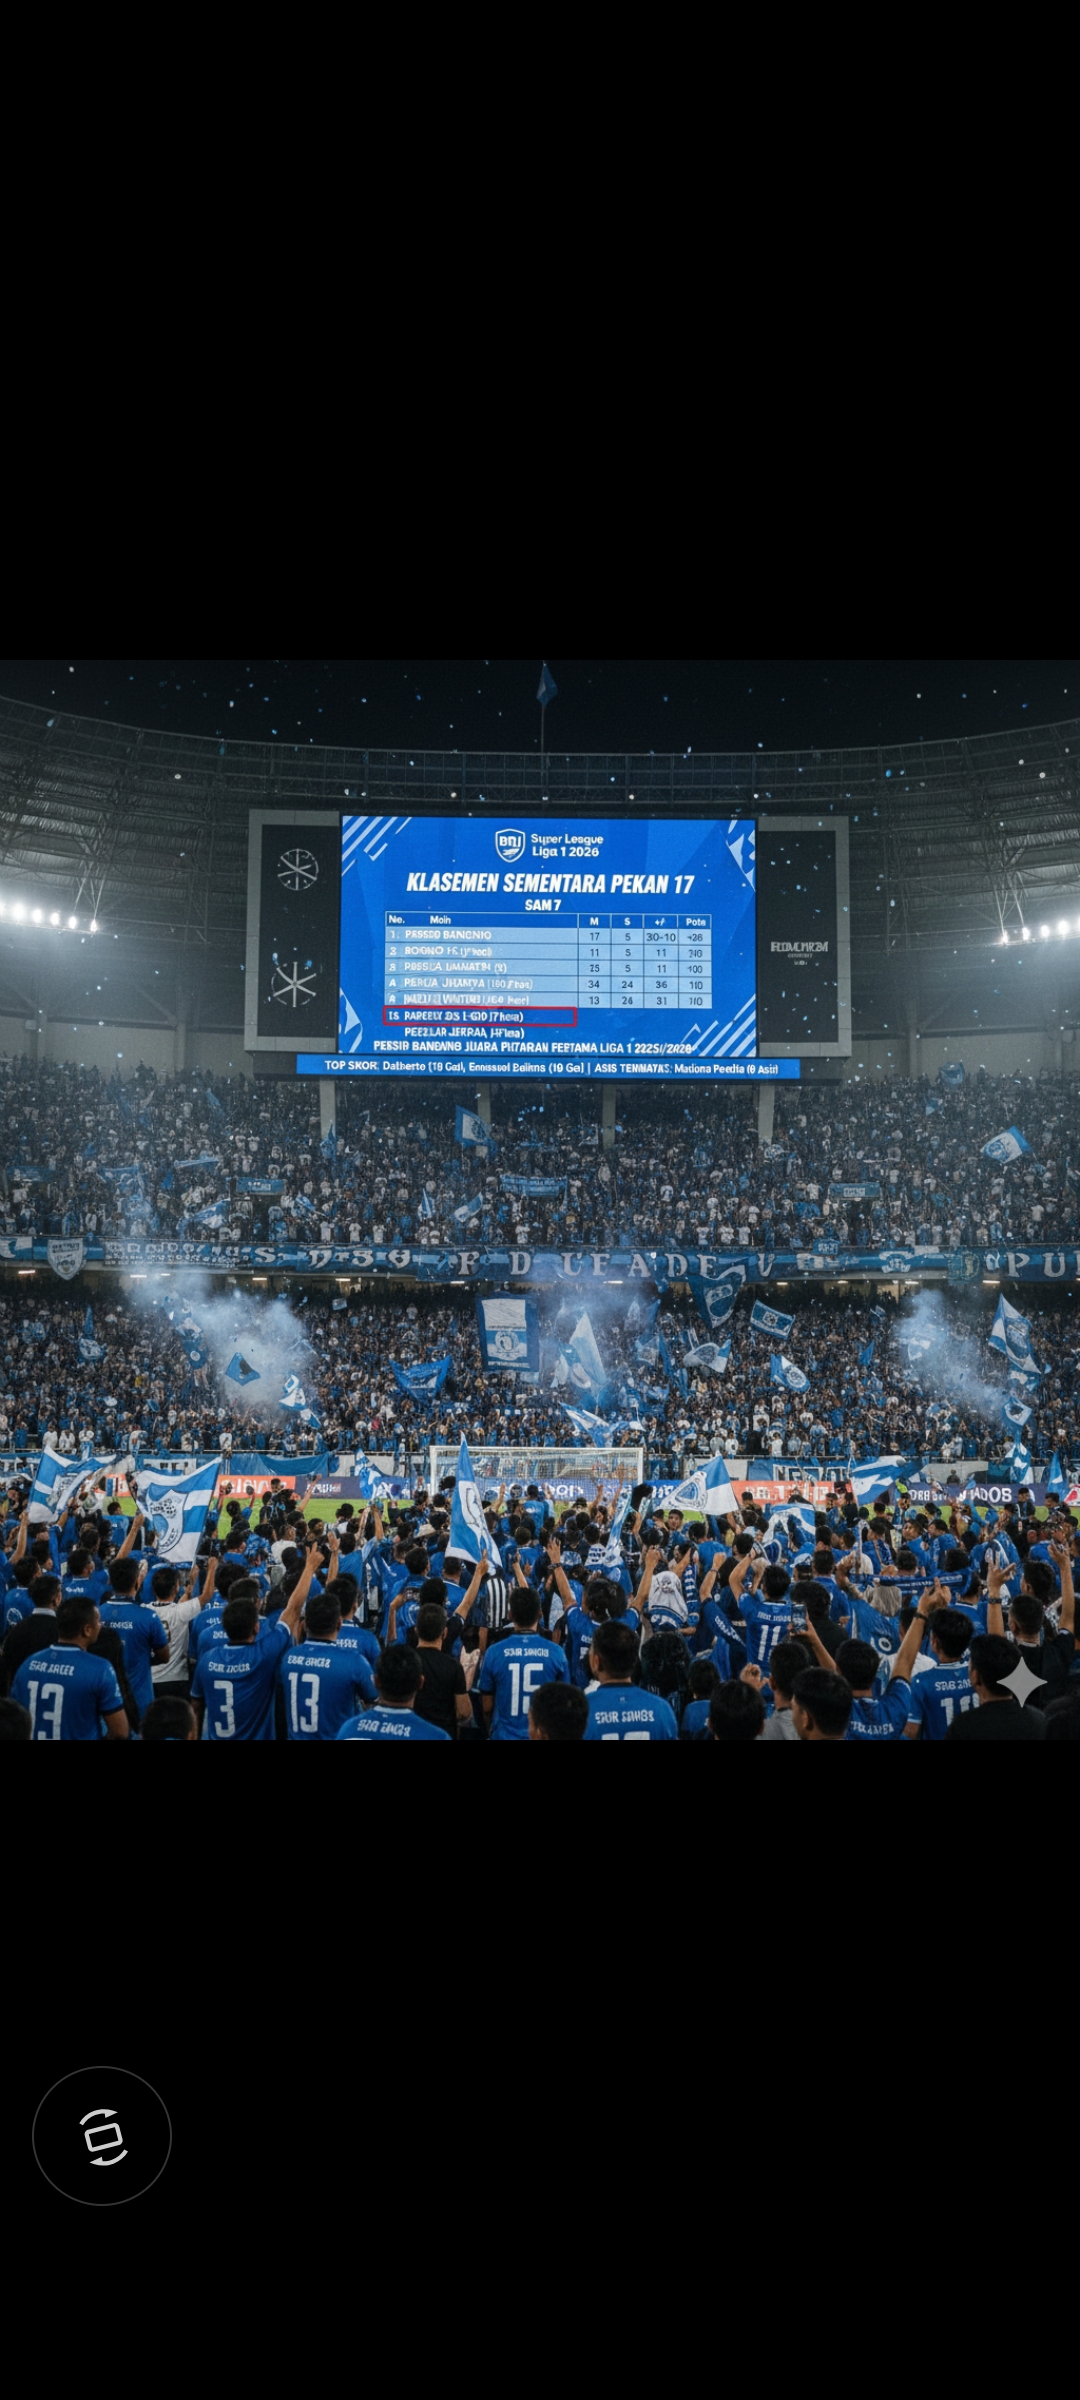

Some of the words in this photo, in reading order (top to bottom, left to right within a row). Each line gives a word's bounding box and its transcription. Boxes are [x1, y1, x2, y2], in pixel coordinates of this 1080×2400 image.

[532, 847, 558, 858] Liga
[560, 847, 566, 856] 1
[568, 847, 600, 857] 2026
[406, 872, 500, 892] KLASEMEN
[502, 873, 606, 893] SEMENTARA
[610, 874, 669, 894] PEKAN
[674, 875, 696, 894] 17
[525, 899, 552, 911] SAM
[554, 900, 562, 911] 7
[590, 917, 599, 925] M
[624, 917, 631, 925] S
[590, 932, 600, 941] 17
[625, 933, 631, 941] 5
[646, 933, 676, 942] 30-10
[590, 949, 599, 957] 11
[656, 949, 667, 957] 11
[625, 965, 632, 973] 5
[657, 965, 667, 974] 11
[588, 980, 600, 989] 34
[621, 981, 633, 989] 24
[655, 981, 667, 989] 36
[589, 996, 600, 1005] 13
[656, 997, 668, 1006] 31
[600, 1044, 625, 1054] LIGA
[627, 1044, 632, 1053] 1
[324, 1060, 346, 1070] TOP
[594, 1064, 617, 1074] ASIS
[288, 1672, 320, 1733] 13
[27, 1680, 65, 1740] 13
[213, 1680, 236, 1738] 3
